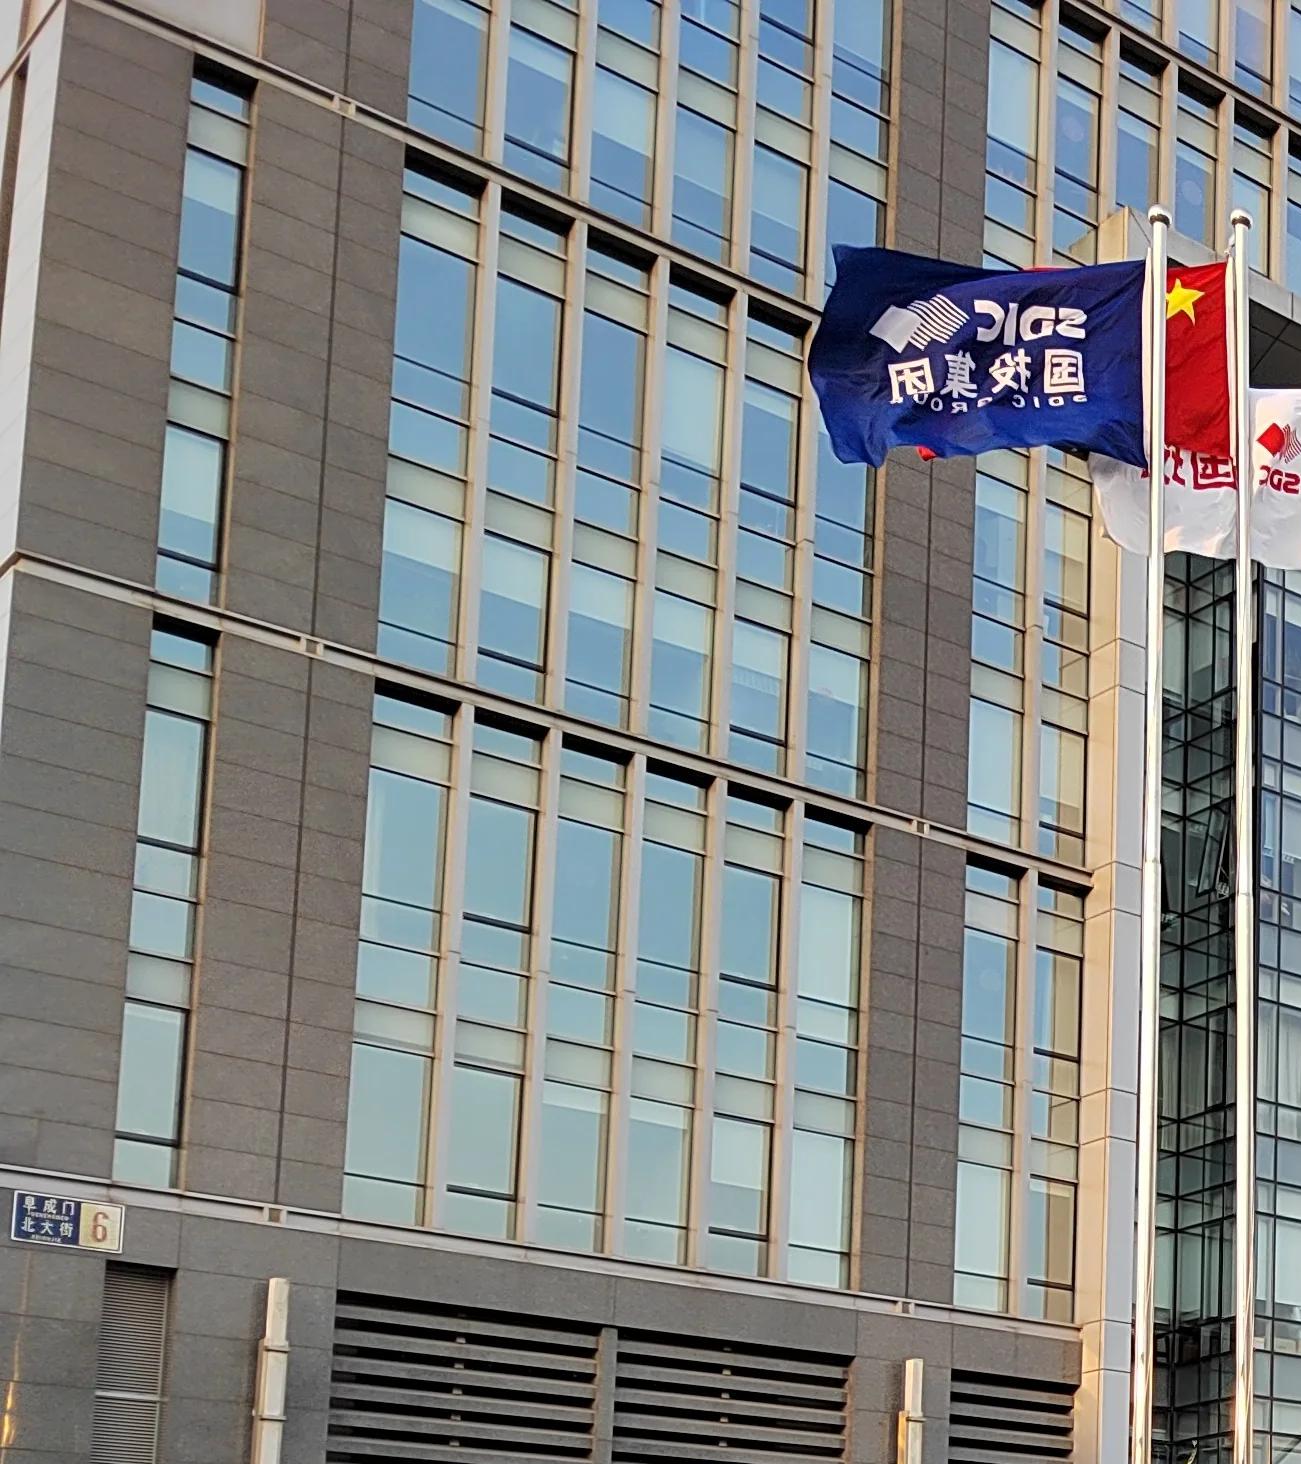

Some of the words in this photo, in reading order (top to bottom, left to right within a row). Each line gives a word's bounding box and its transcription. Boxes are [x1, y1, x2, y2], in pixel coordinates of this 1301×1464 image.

[21, 1217, 73, 1238] 北大街
[92, 1212, 109, 1242] 6
